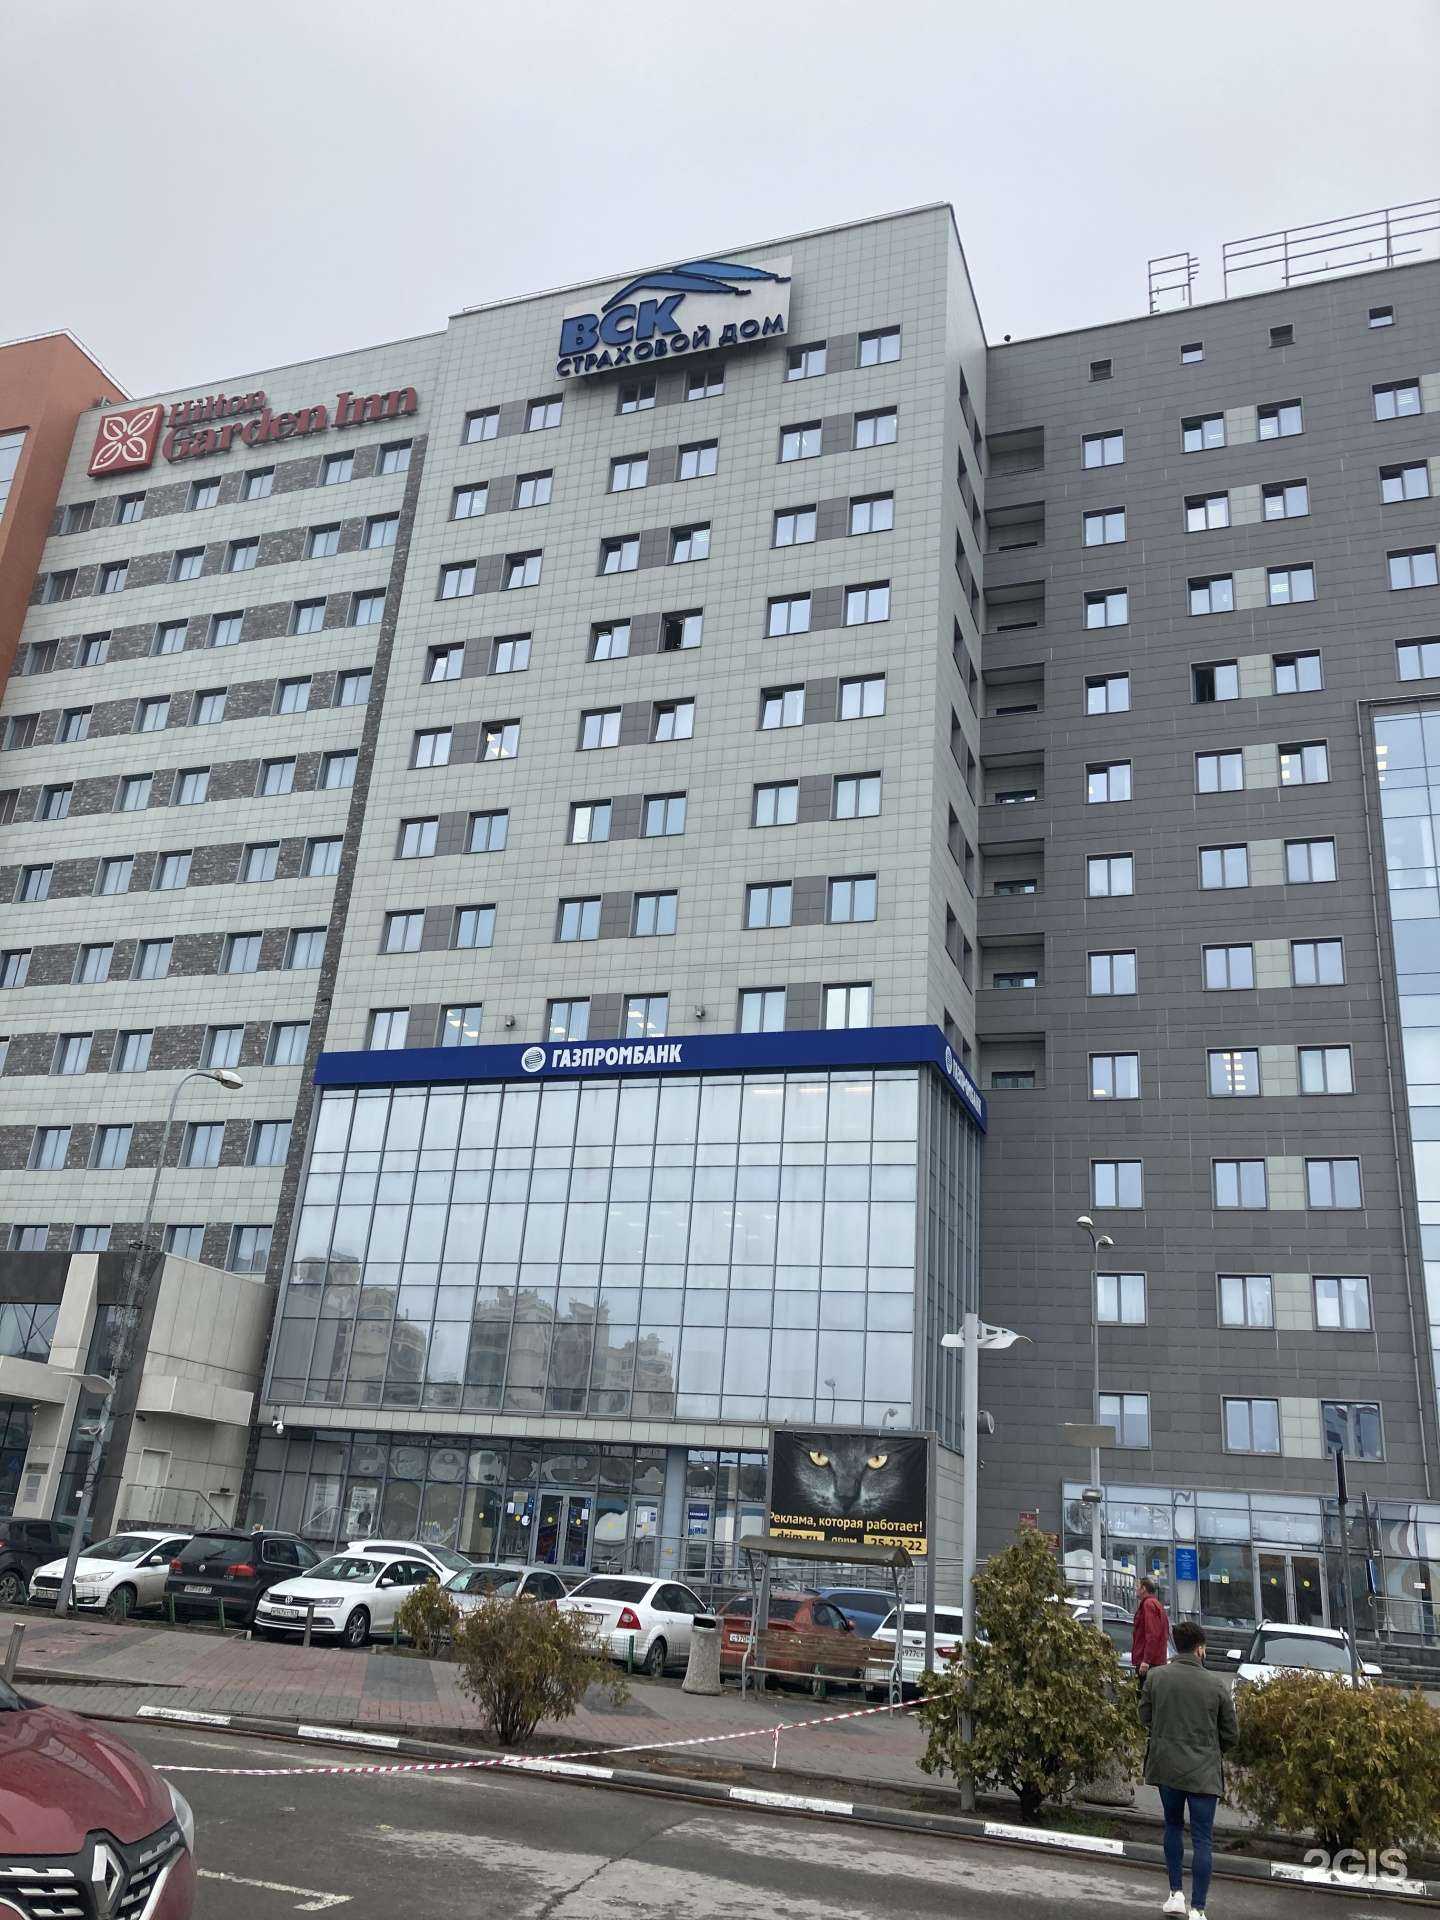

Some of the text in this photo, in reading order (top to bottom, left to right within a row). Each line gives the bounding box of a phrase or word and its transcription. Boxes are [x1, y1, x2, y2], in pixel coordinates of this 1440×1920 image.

[556, 314, 785, 377] СТРАХОВОЙ ДОМ
[559, 294, 686, 357] ВСК
[161, 386, 418, 463] Garden Inn
[167, 390, 268, 427] Hilton
[551, 1043, 683, 1068] ГАЗПРОМБАНК
[818, 1516, 863, 1531] которая
[866, 1518, 923, 1533] работает!
